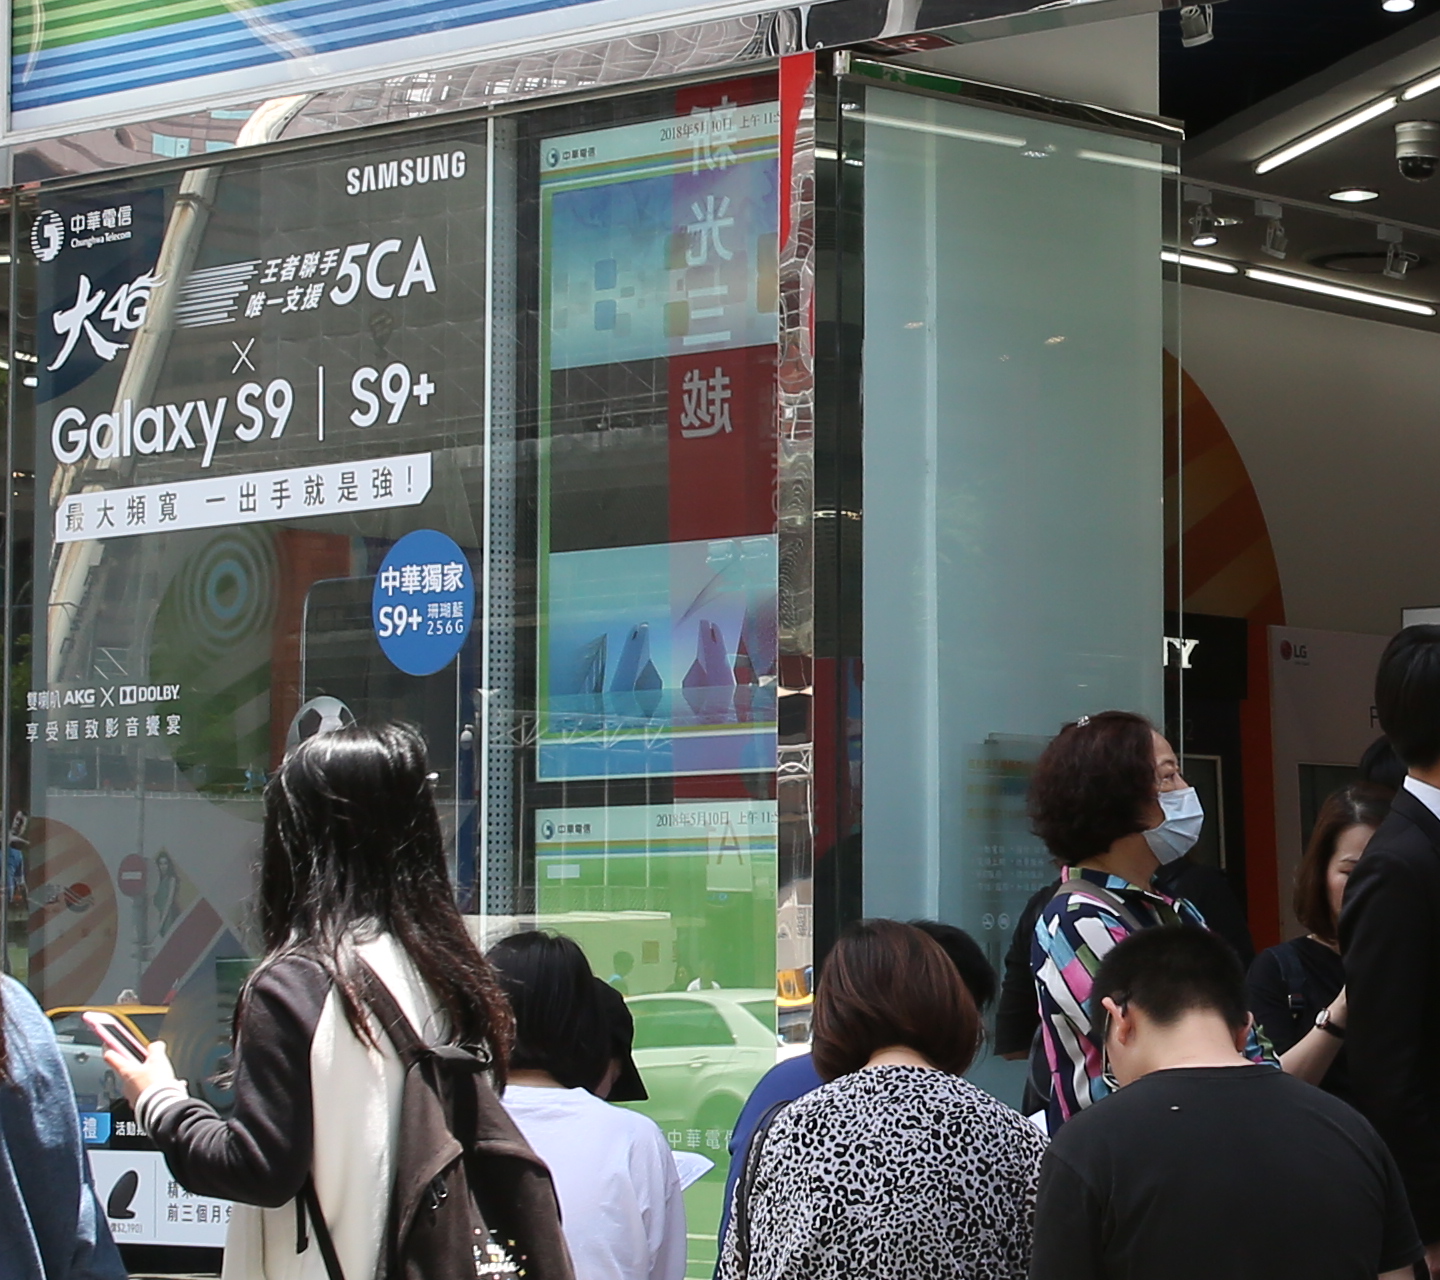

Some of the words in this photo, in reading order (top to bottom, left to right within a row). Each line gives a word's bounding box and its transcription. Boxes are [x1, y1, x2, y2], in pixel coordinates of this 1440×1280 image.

[346, 150, 467, 196] SAMSUNG
[70, 205, 133, 234] 中華電信
[263, 247, 340, 284] 王者聯手
[329, 234, 438, 307] 5CA
[244, 282, 325, 319] 唯一支援
[50, 396, 227, 468] Galaxy
[234, 377, 295, 443] S9
[350, 361, 436, 428] S9+
[64, 488, 179, 534] 最大頻寬
[380, 561, 465, 596] 中華獨家
[378, 604, 422, 638] S9+
[426, 618, 465, 636] 256G
[63, 688, 96, 709] AKG
[138, 684, 180, 702] DOLBY
[25, 714, 181, 743] 享受極致影音饗宴
